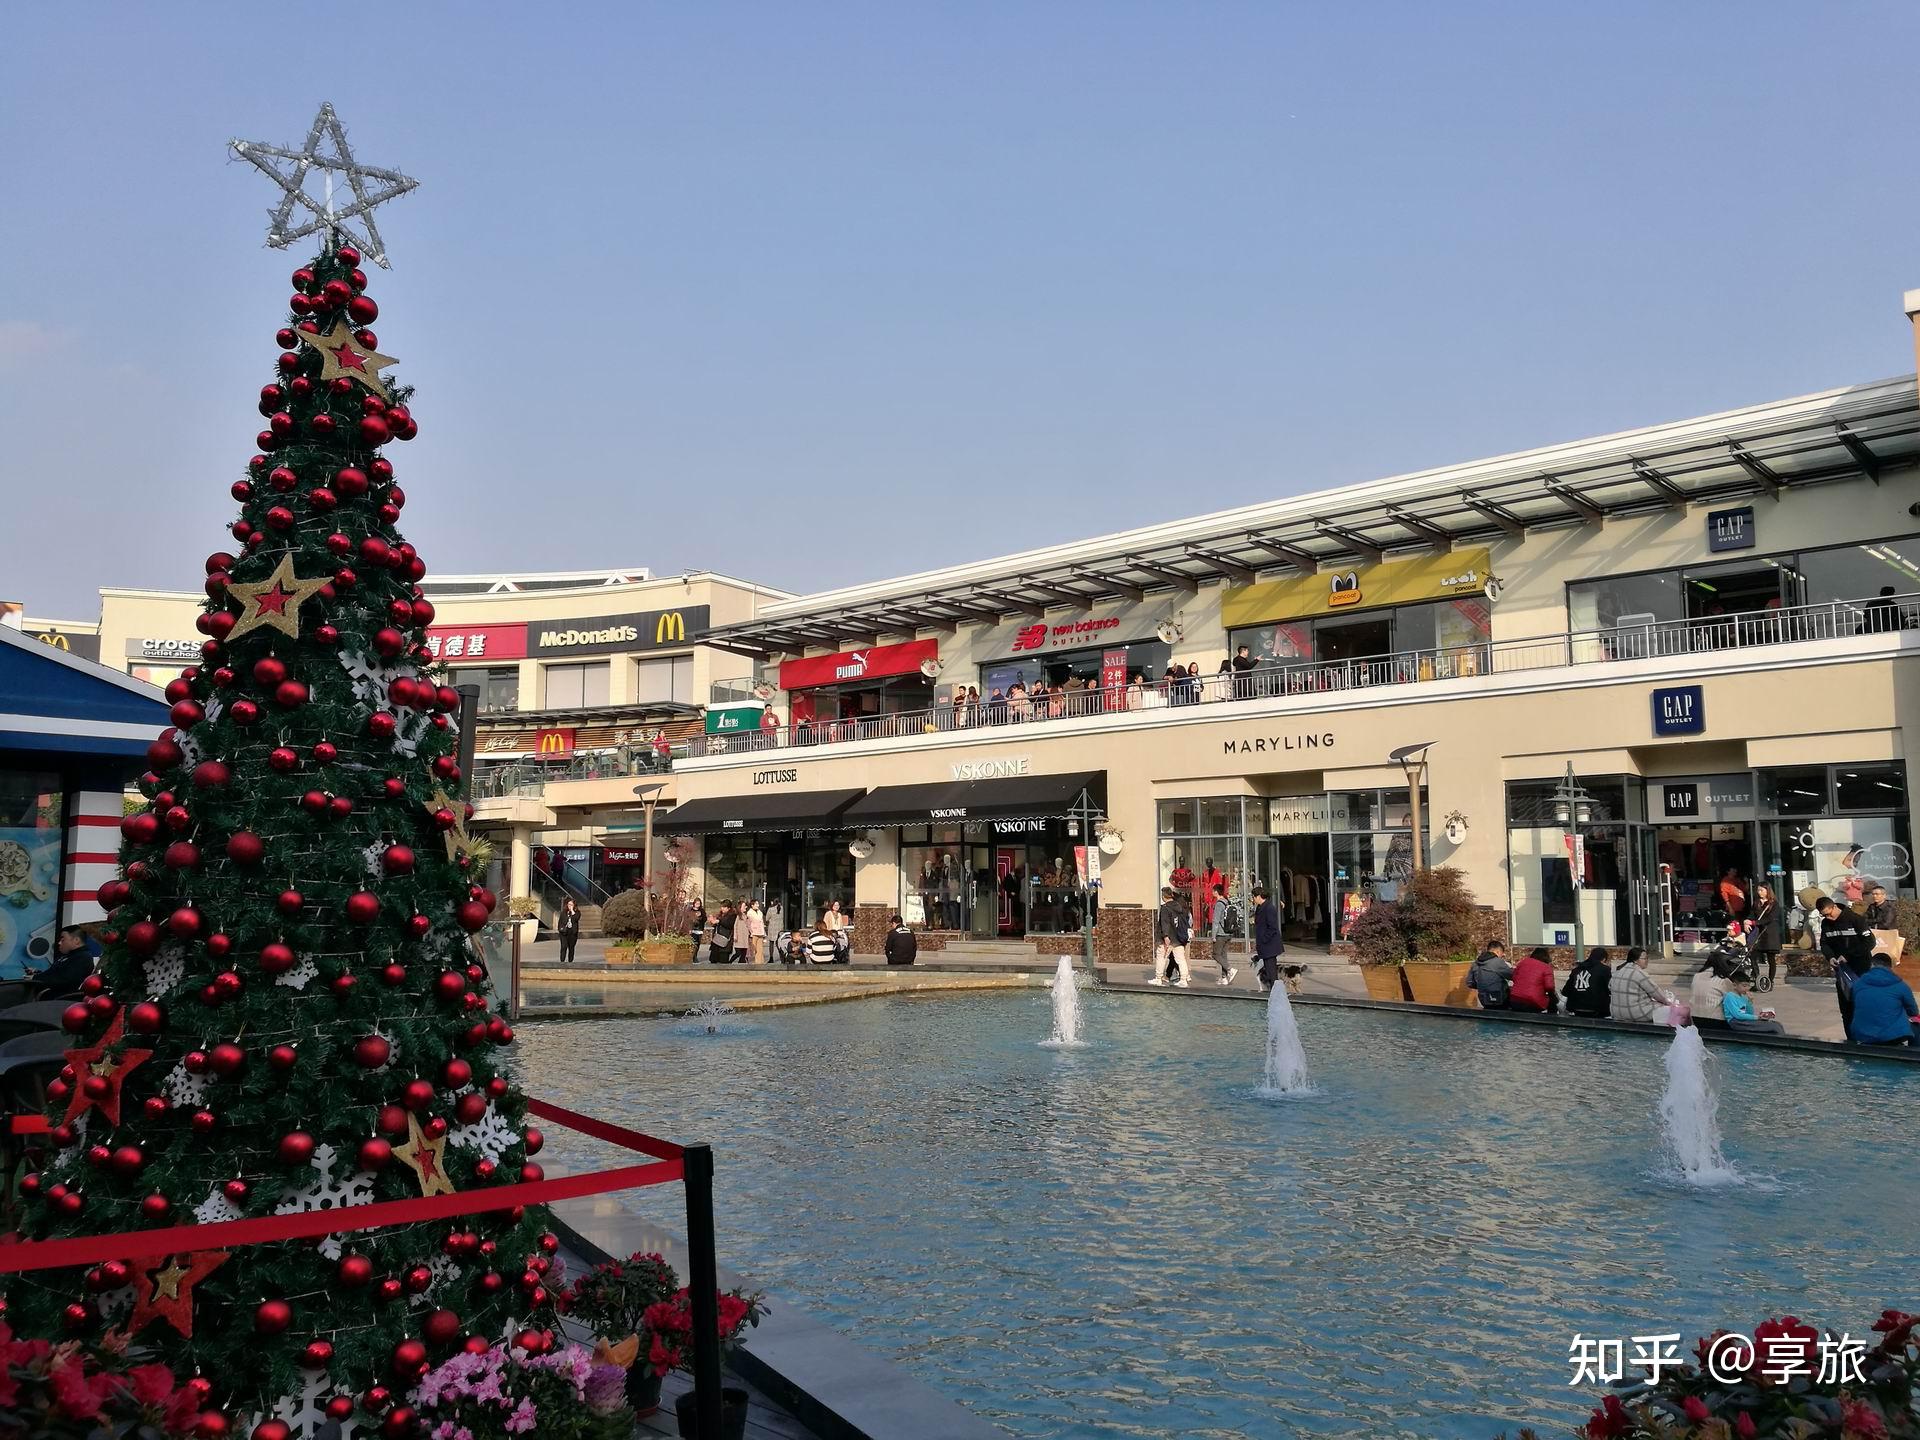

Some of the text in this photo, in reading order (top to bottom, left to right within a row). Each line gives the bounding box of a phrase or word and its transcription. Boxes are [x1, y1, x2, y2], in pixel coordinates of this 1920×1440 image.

[1717, 515, 1743, 536] GAP
[1052, 617, 1120, 636] new balance
[142, 639, 201, 651] crocs
[539, 626, 638, 648] McDonald's
[1052, 634, 1098, 646] OUTLET
[144, 649, 199, 658] outlet shop
[425, 634, 487, 657] 肯德基
[1104, 656, 1127, 667] SALE
[836, 664, 863, 679] PUMA
[1108, 670, 1123, 680] 2件
[1663, 694, 1693, 718] GAP
[1224, 733, 1334, 754] MARYLING
[753, 769, 797, 785] LOTTUSSE
[951, 758, 1029, 780] VSKONNE
[1670, 792, 1751, 808] GAP OUTLET
[930, 808, 967, 818] VSKONNE
